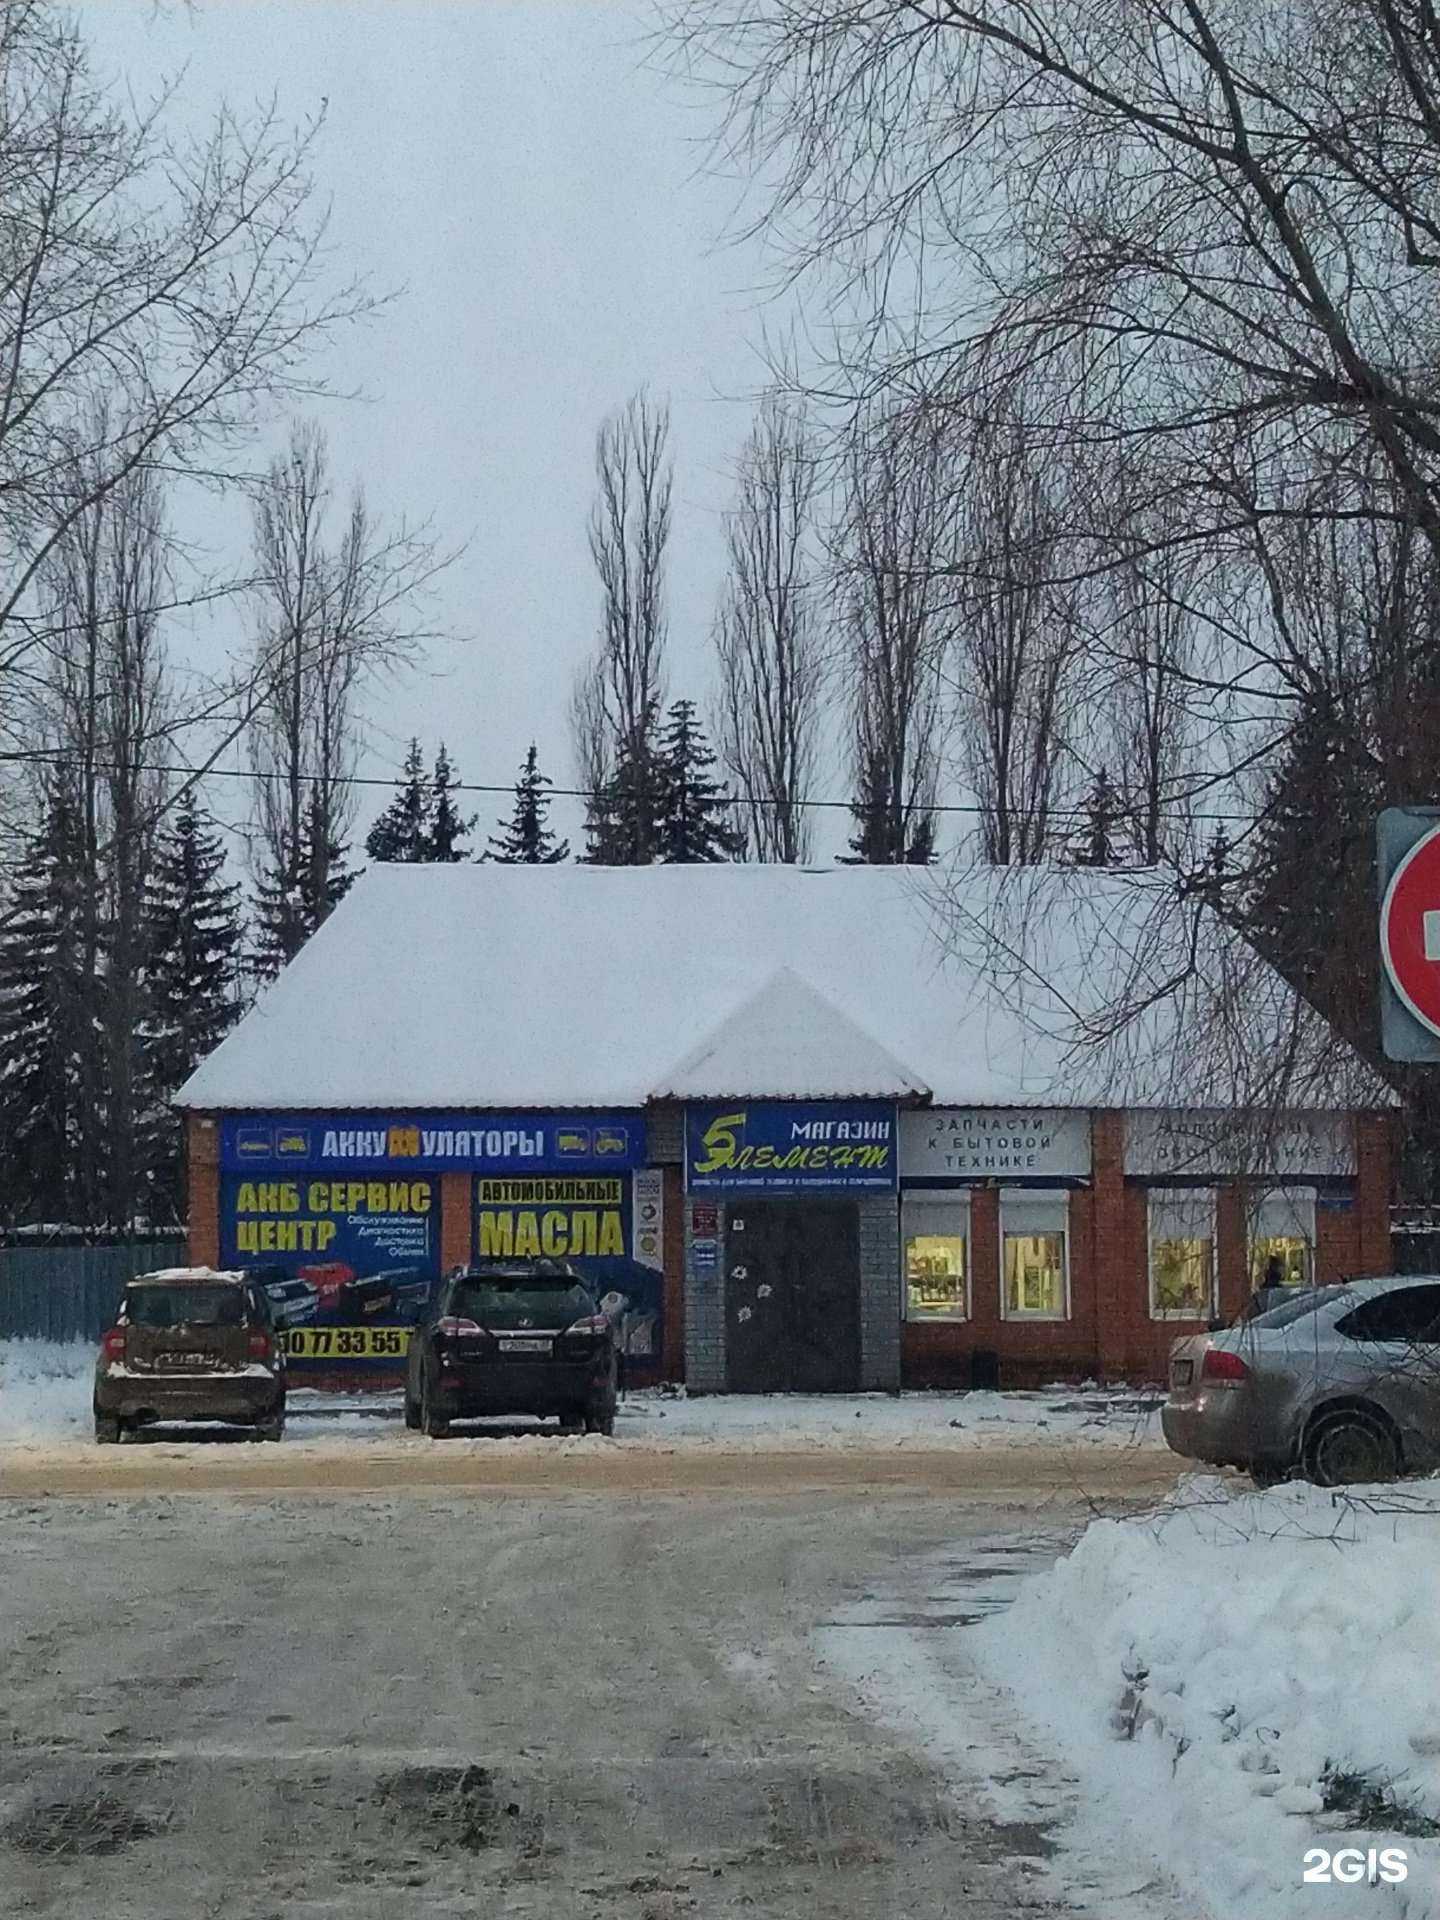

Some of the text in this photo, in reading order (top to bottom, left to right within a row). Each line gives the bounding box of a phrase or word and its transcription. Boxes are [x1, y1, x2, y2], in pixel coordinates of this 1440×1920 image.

[791, 1121, 890, 1140] МАГАЗИН
[935, 1119, 1044, 1132] ЗАПЧАСТИ
[928, 1136, 1051, 1150] К БЫТОВОЙ
[945, 1155, 1036, 1168] ТЕХНИКЕ
[237, 1182, 432, 1213] АКБ СЕРВИС
[482, 1181, 620, 1201] АВТОМОБИЛЬНЫЕ
[237, 1220, 337, 1256] ЦЕНТР
[479, 1211, 625, 1256] МАСЛА
[309, 1331, 333, 1354] 77
[337, 1331, 367, 1354] 33
[371, 1331, 401, 1354] 55
